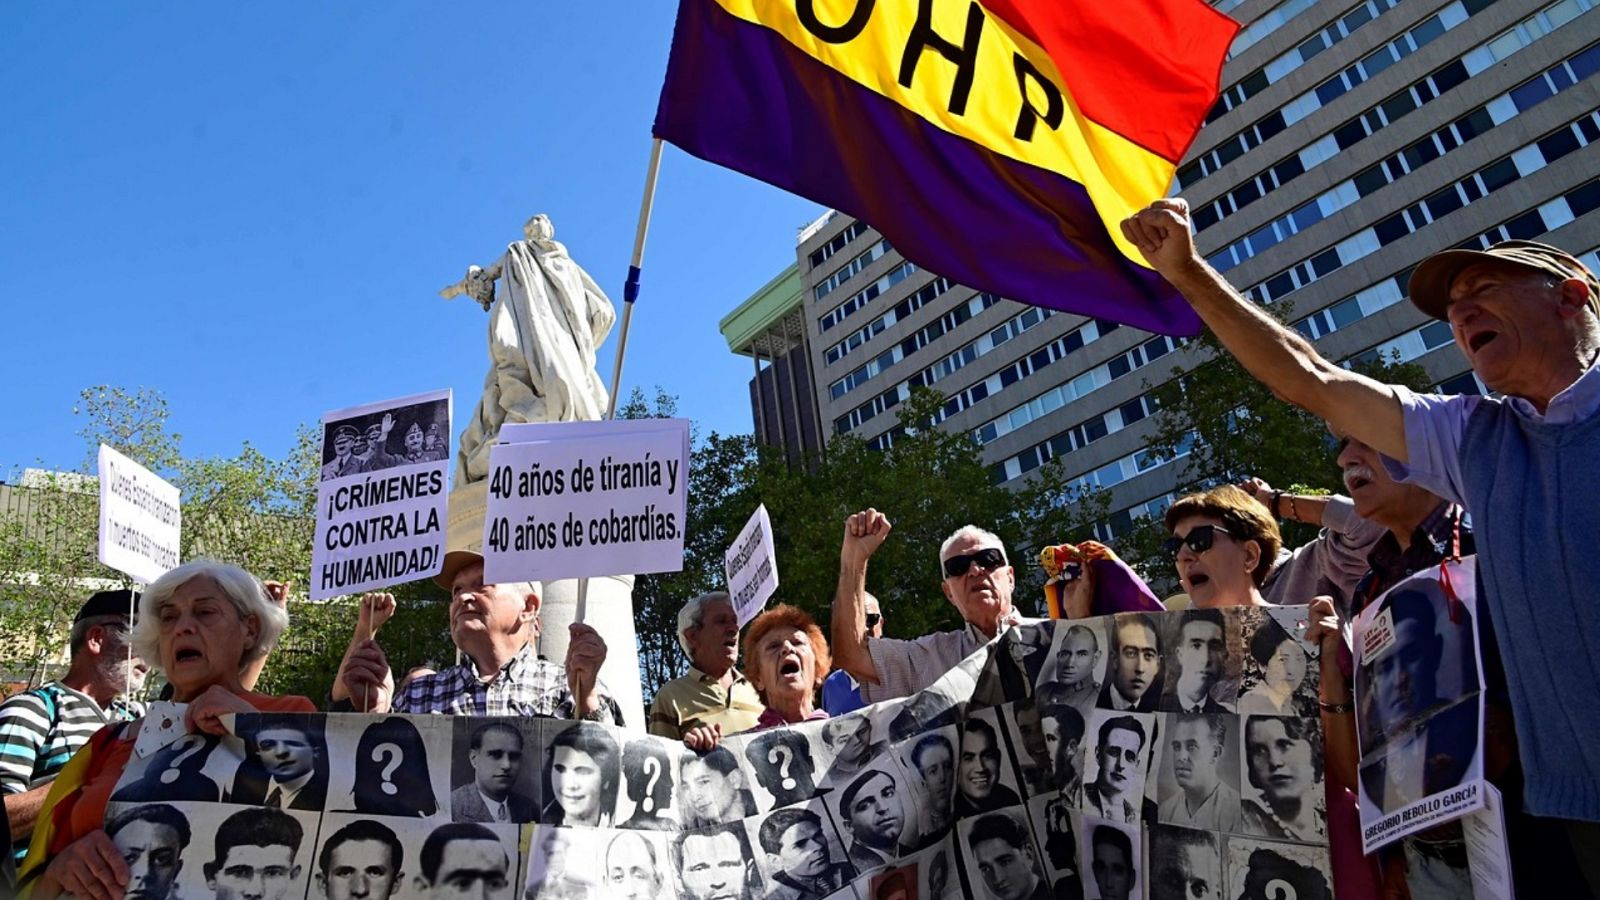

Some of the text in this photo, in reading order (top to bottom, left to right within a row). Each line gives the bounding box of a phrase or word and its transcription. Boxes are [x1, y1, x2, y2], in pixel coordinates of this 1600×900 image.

[328, 470, 442, 520] ¡CRÍMENES
[490, 452, 679, 499] 40 años de tiranía y
[325, 507, 440, 551] CONTRA LA
[489, 504, 681, 552] 40 años de cobardías.
[321, 544, 439, 590] HUMANIDAD!
[1365, 784, 1476, 840] GREGORIO REBOLLO GARCÍA
